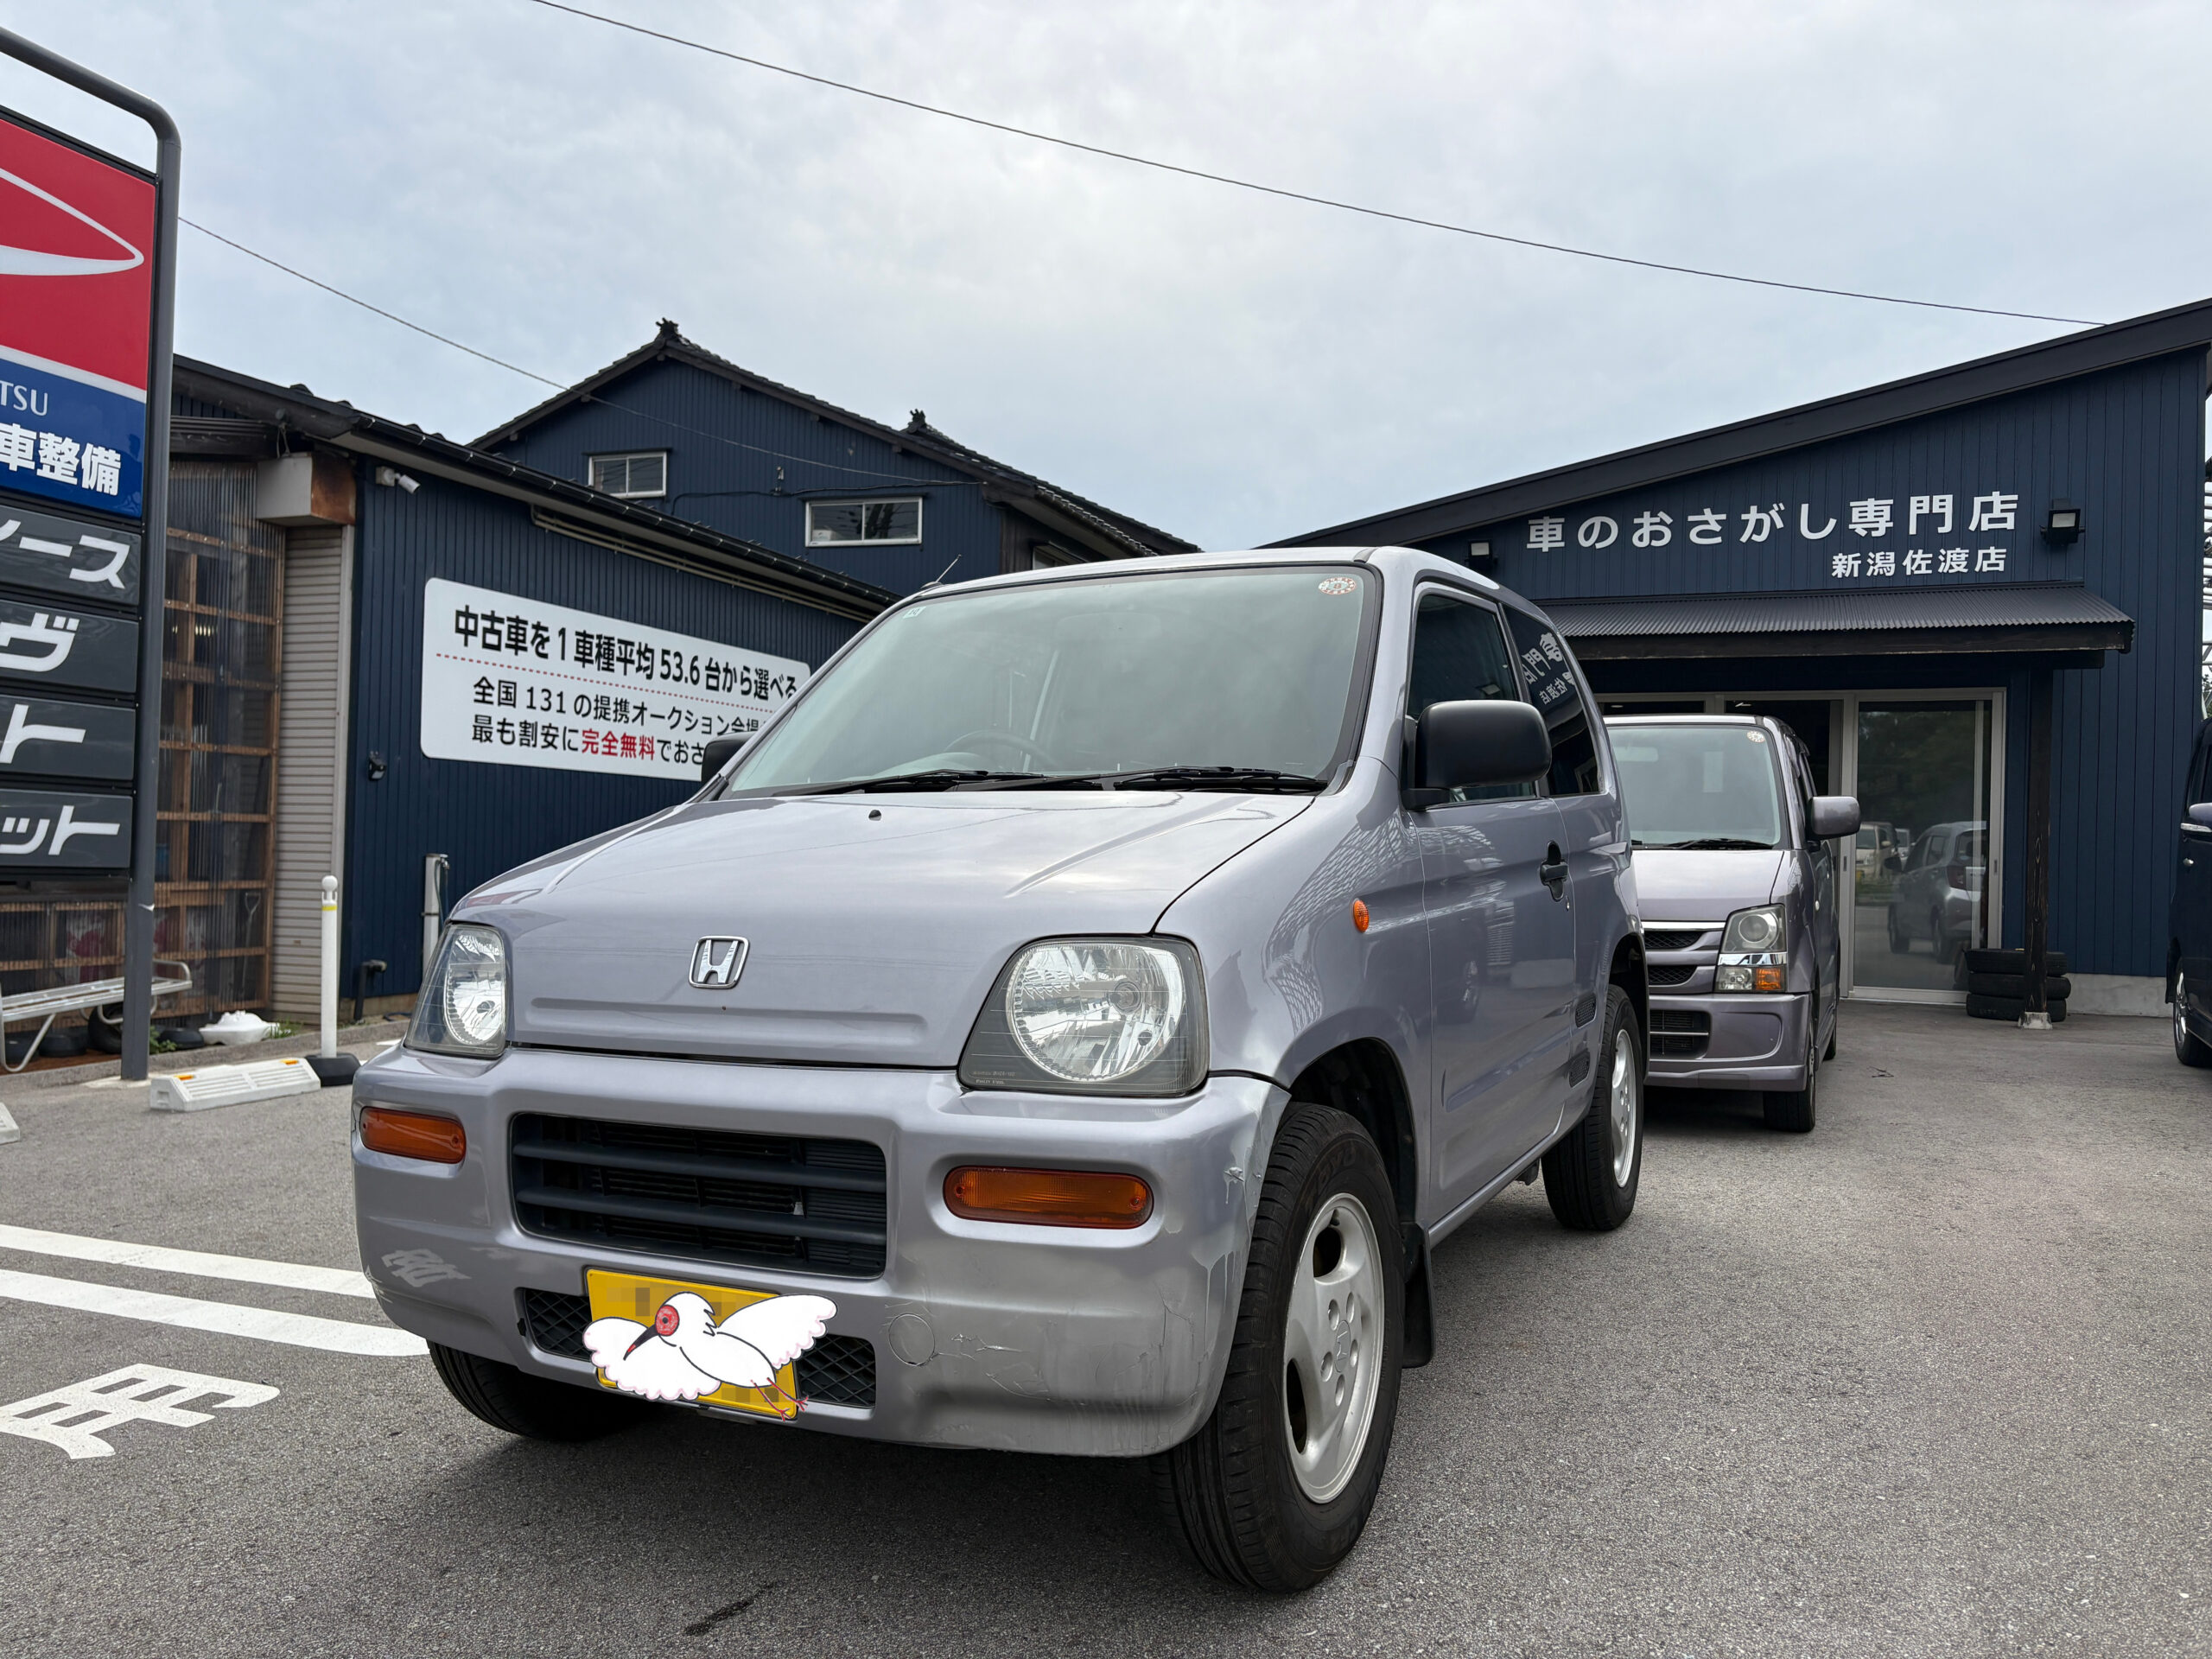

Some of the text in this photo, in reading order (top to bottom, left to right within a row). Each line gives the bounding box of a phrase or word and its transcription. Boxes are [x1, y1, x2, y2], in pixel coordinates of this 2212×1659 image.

[0, 380, 48, 416] TSU
[0, 423, 121, 496] 車整備
[1526, 491, 2019, 553] 車のおさがし専門店
[1831, 546, 2007, 579] 新潟佐渡店
